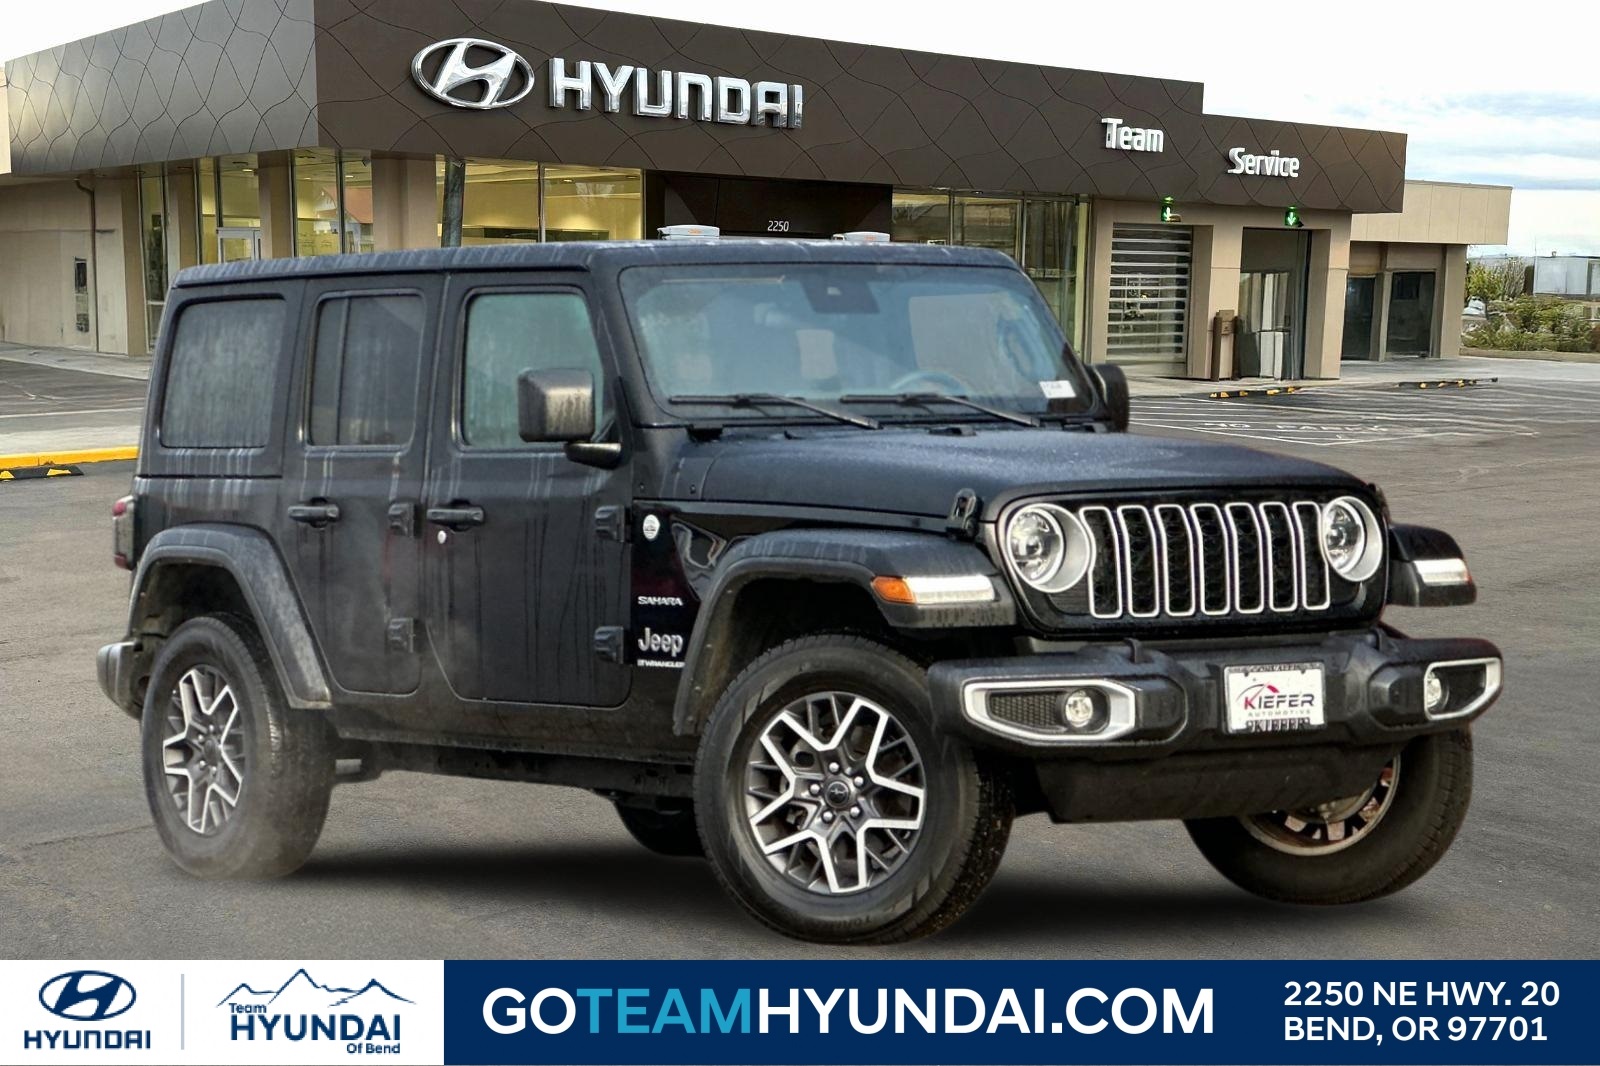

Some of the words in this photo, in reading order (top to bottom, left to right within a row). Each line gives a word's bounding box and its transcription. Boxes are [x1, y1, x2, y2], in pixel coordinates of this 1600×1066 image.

[549, 57, 804, 128] HYUNDAI
[1101, 117, 1165, 153] Team
[1227, 146, 1301, 178] Service
[767, 220, 790, 232] 2250
[637, 595, 684, 606] SAHARA
[637, 627, 684, 657] Jeep
[1244, 694, 1315, 710] KIEFER
